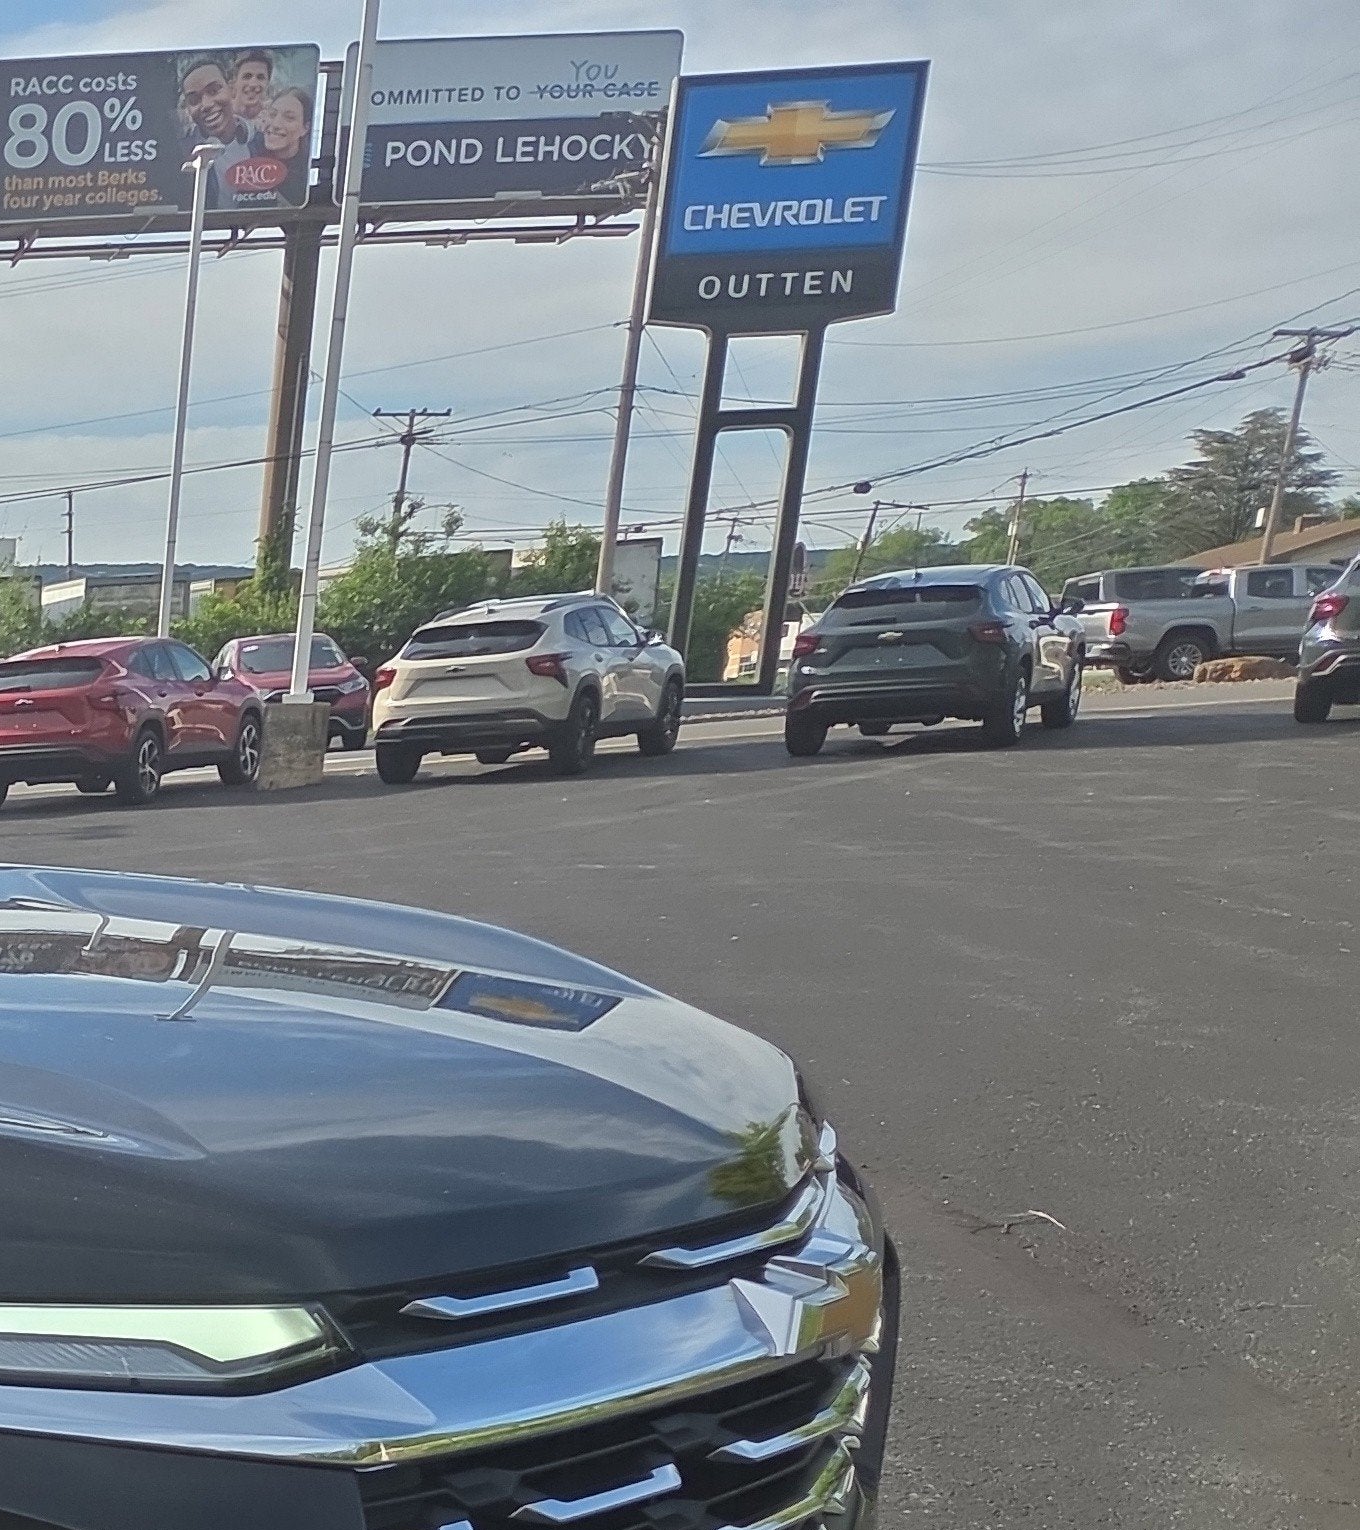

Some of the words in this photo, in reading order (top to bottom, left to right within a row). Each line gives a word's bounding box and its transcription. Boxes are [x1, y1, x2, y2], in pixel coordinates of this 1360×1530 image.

[10, 78, 74, 97] RACC
[80, 72, 137, 93] costs
[370, 87, 485, 106] OMMITTED
[493, 85, 521, 101] TO
[536, 83, 594, 100] YOUR
[603, 81, 659, 98] CASE
[3, 96, 143, 169] 80%
[103, 139, 158, 163] LESS
[385, 138, 483, 167] POND
[495, 133, 653, 163] LEHOCKY
[4, 174, 45, 191] than
[48, 171, 93, 188] most
[97, 169, 147, 186] Berks
[234, 165, 277, 185] RACC
[4, 193, 40, 210] four
[42, 193, 82, 211] year
[85, 187, 163, 206] colleges.
[233, 190, 278, 201] racc.edu
[684, 196, 887, 231] CHEVROLET
[698, 269, 853, 300] OUTTEN
